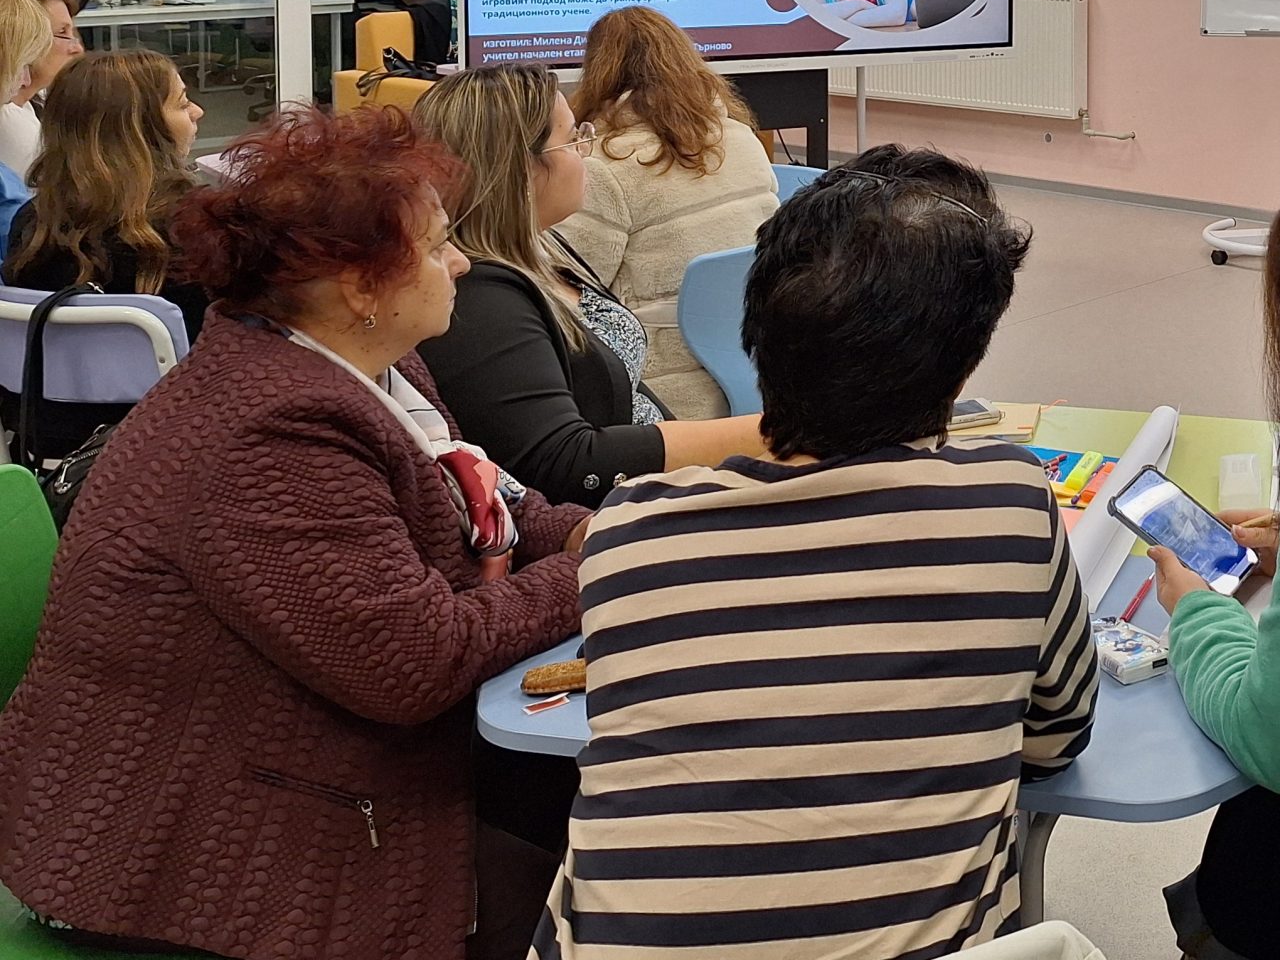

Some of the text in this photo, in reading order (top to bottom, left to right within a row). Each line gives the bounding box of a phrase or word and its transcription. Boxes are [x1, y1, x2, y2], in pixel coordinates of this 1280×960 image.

[482, 8, 592, 19] традиционното учене.
[483, 38, 532, 48] изготвил:
[533, 37, 572, 46] Милена
[483, 51, 518, 63] учител
[520, 49, 562, 59] начален
